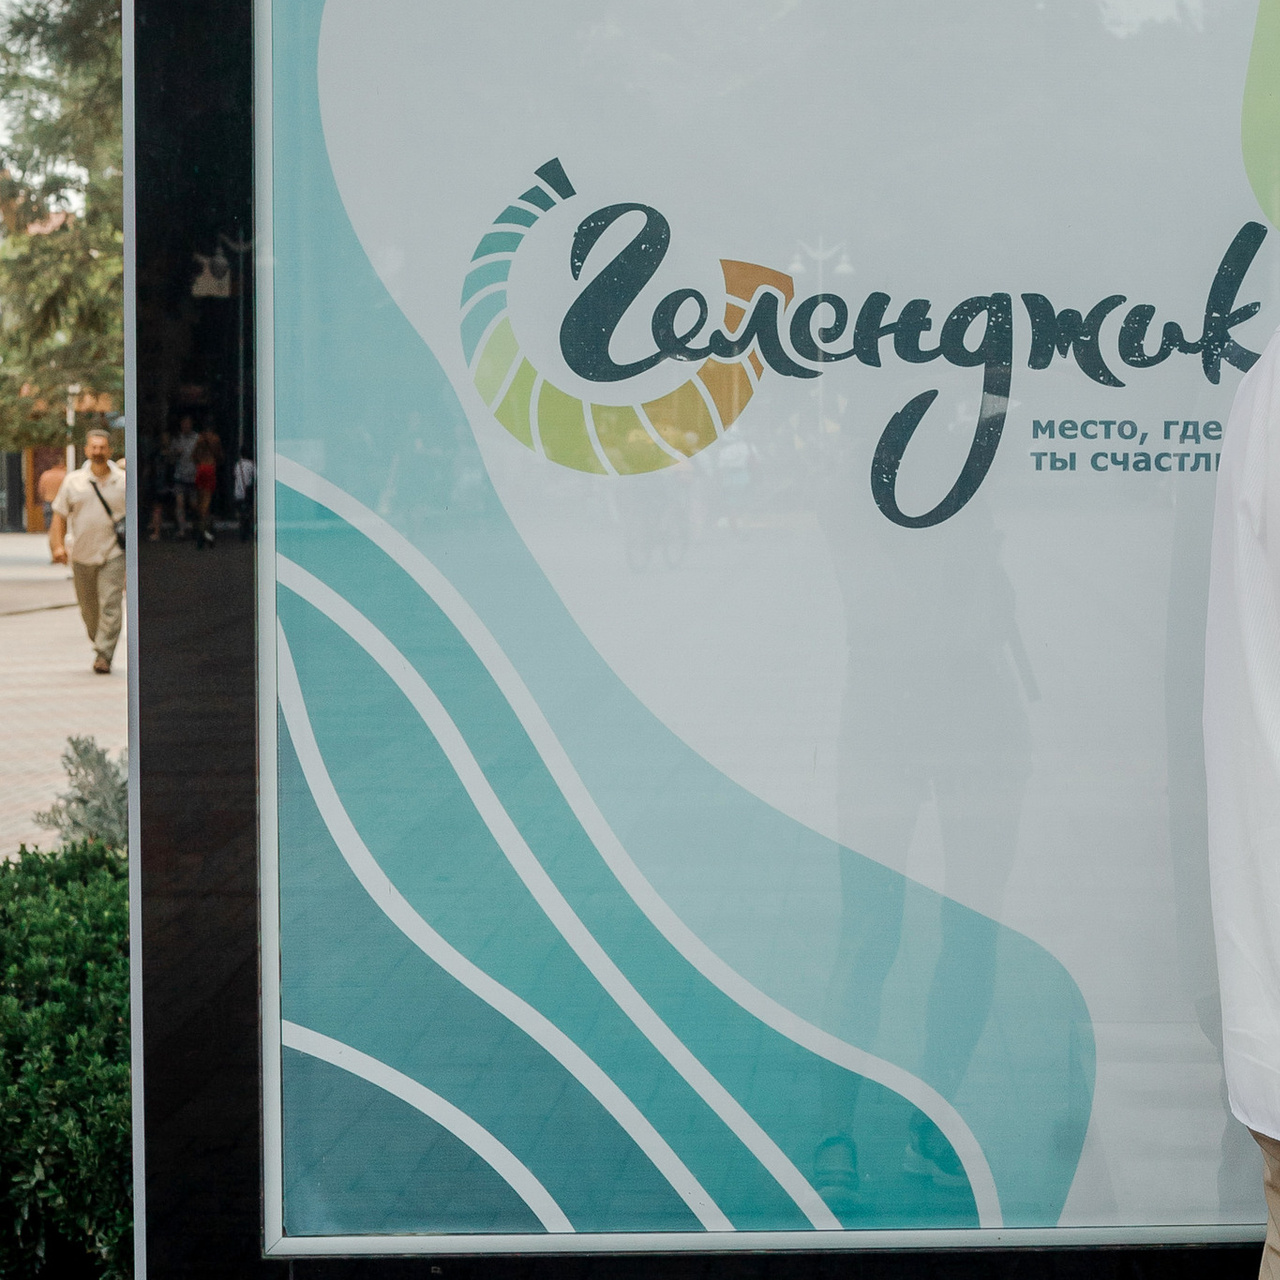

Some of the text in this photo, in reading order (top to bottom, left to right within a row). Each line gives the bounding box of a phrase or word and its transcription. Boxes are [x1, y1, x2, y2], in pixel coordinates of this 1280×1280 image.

[1032, 419, 1223, 446] место, где
[1030, 451, 1221, 472] ты счастл
